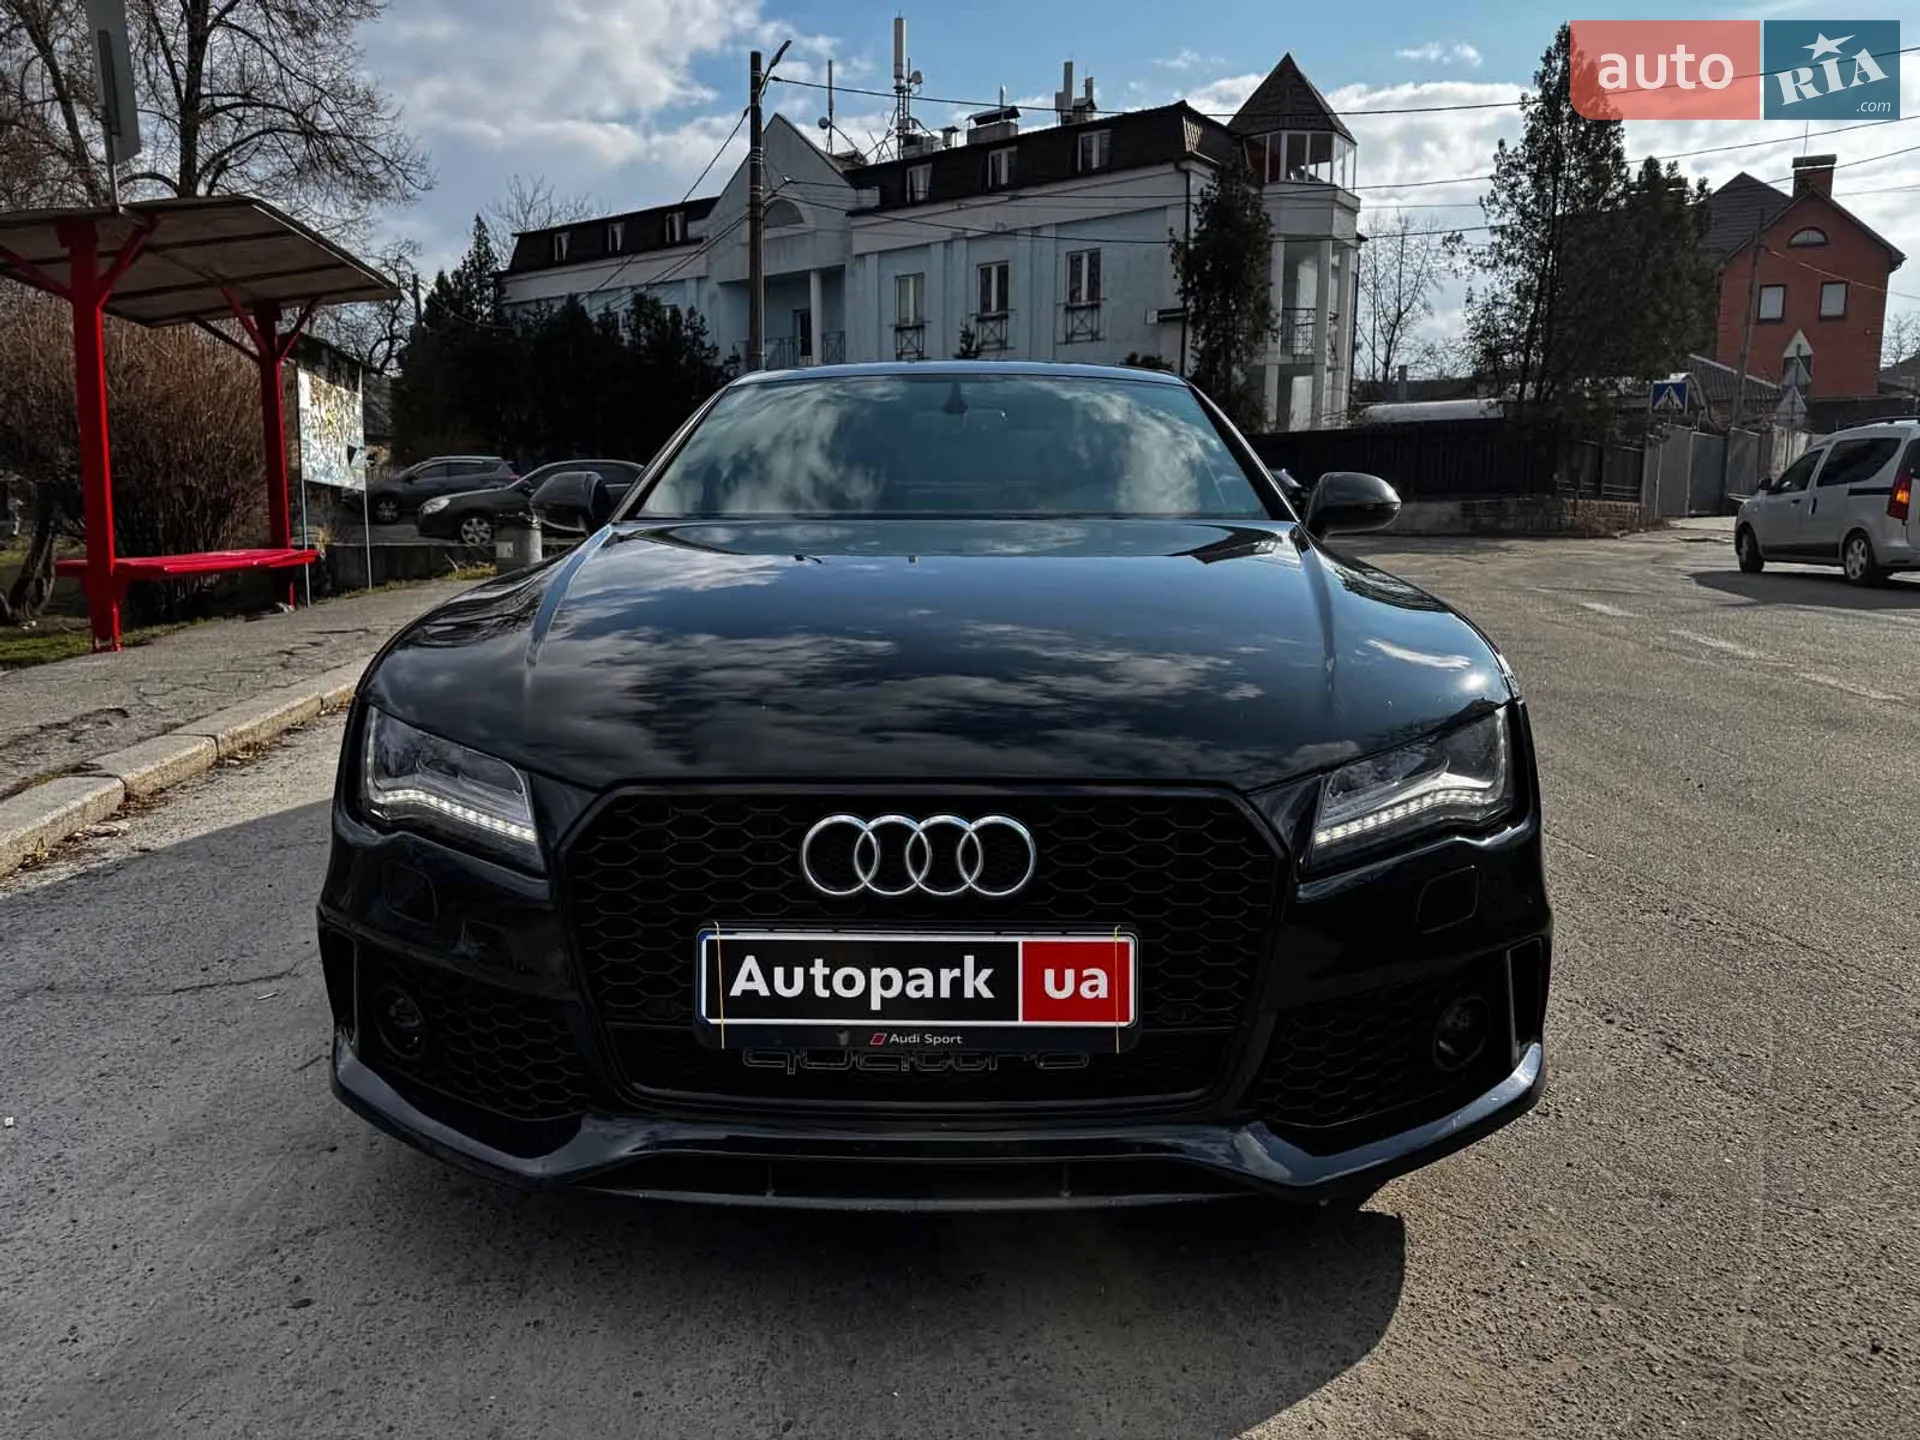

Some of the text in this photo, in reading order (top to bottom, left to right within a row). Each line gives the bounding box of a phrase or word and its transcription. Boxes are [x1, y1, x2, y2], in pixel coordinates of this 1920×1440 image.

[729, 955, 1109, 1010] Autopark ua
[889, 1033, 963, 1047] Audi Sport
